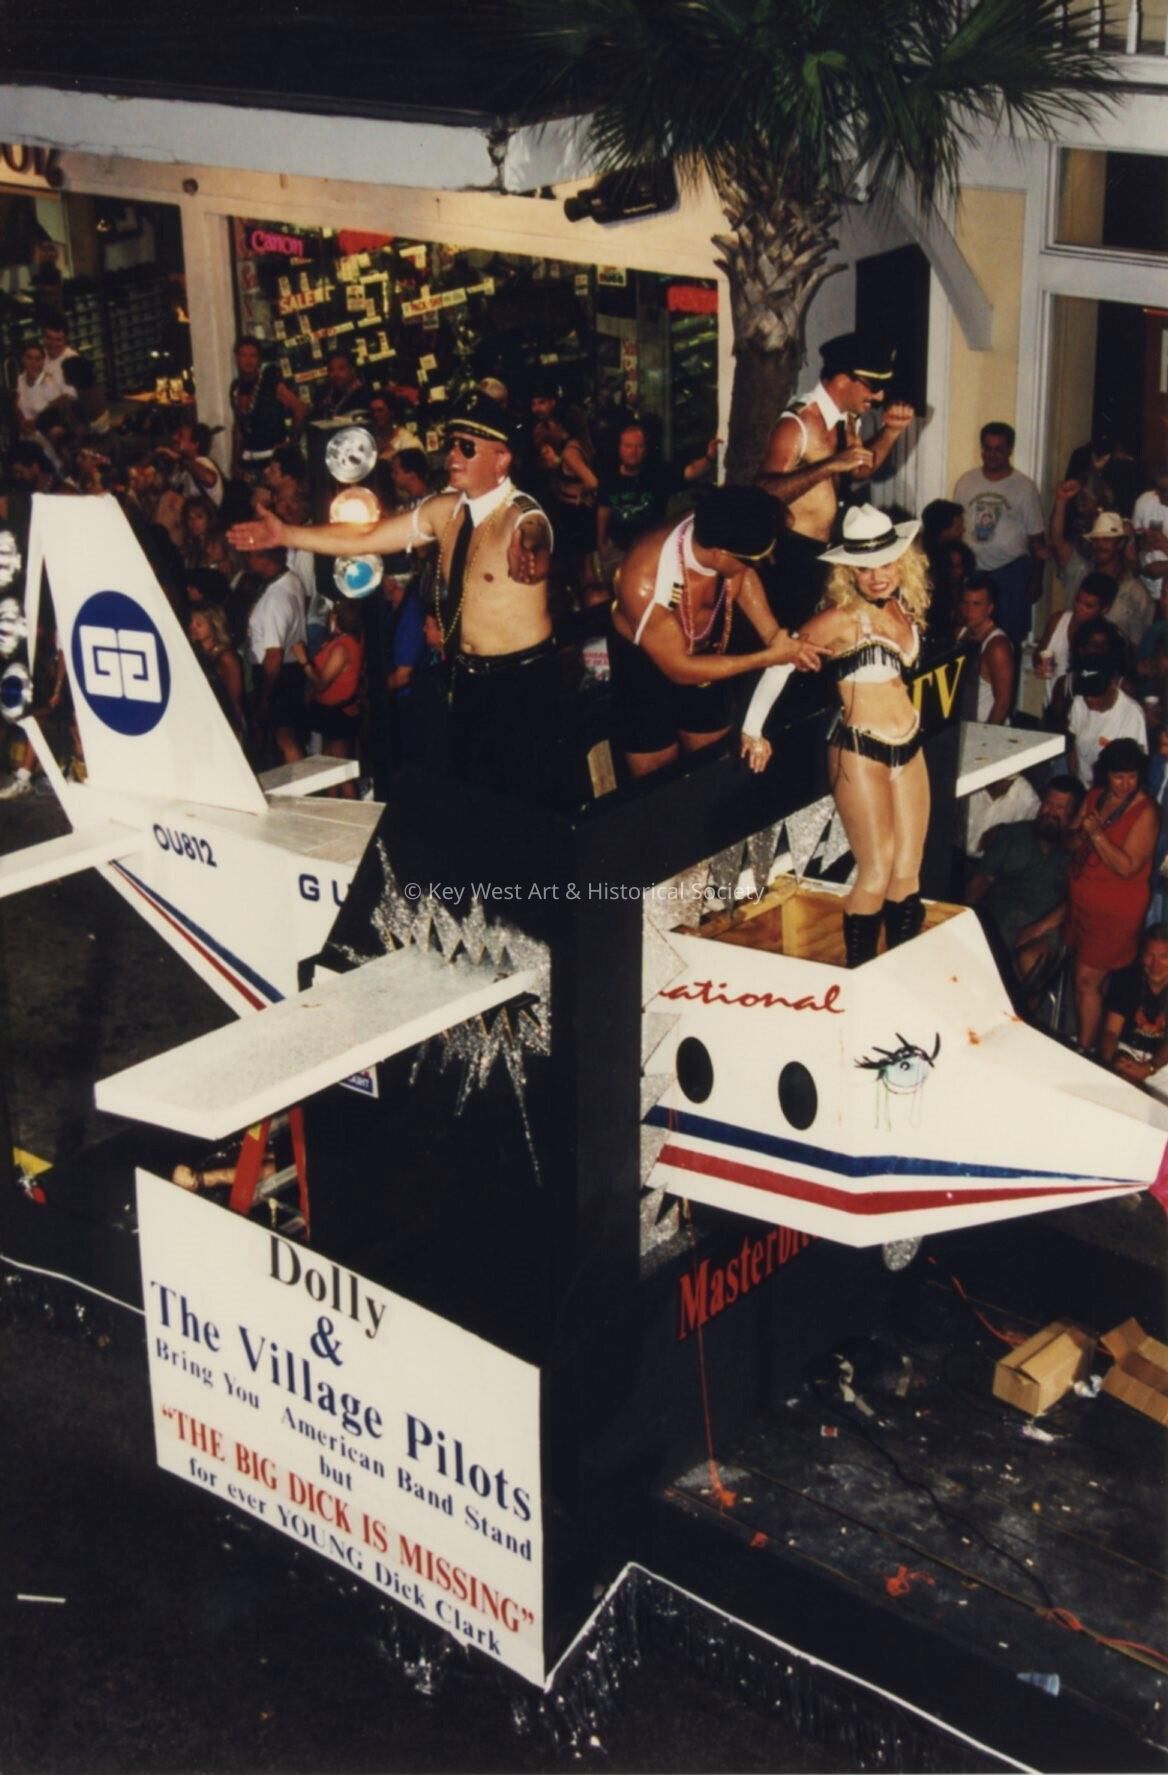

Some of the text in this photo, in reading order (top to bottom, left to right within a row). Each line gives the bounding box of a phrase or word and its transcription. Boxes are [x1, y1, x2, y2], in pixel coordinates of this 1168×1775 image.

[251, 229, 303, 258] Canon
[153, 823, 217, 868] OU812
[268, 1234, 388, 1340] Dolly
[310, 1315, 344, 1367] &
[150, 1280, 533, 1524] The Village Pilots
[155, 1340, 533, 1562] Bring You American Band Stand
[235, 1438, 278, 1492] BIG
[288, 1474, 352, 1534] DICK
[362, 1512, 390, 1554] IS
[319, 1454, 353, 1492] but
[188, 1456, 502, 1657] for ever YOUNG Dick Clark
